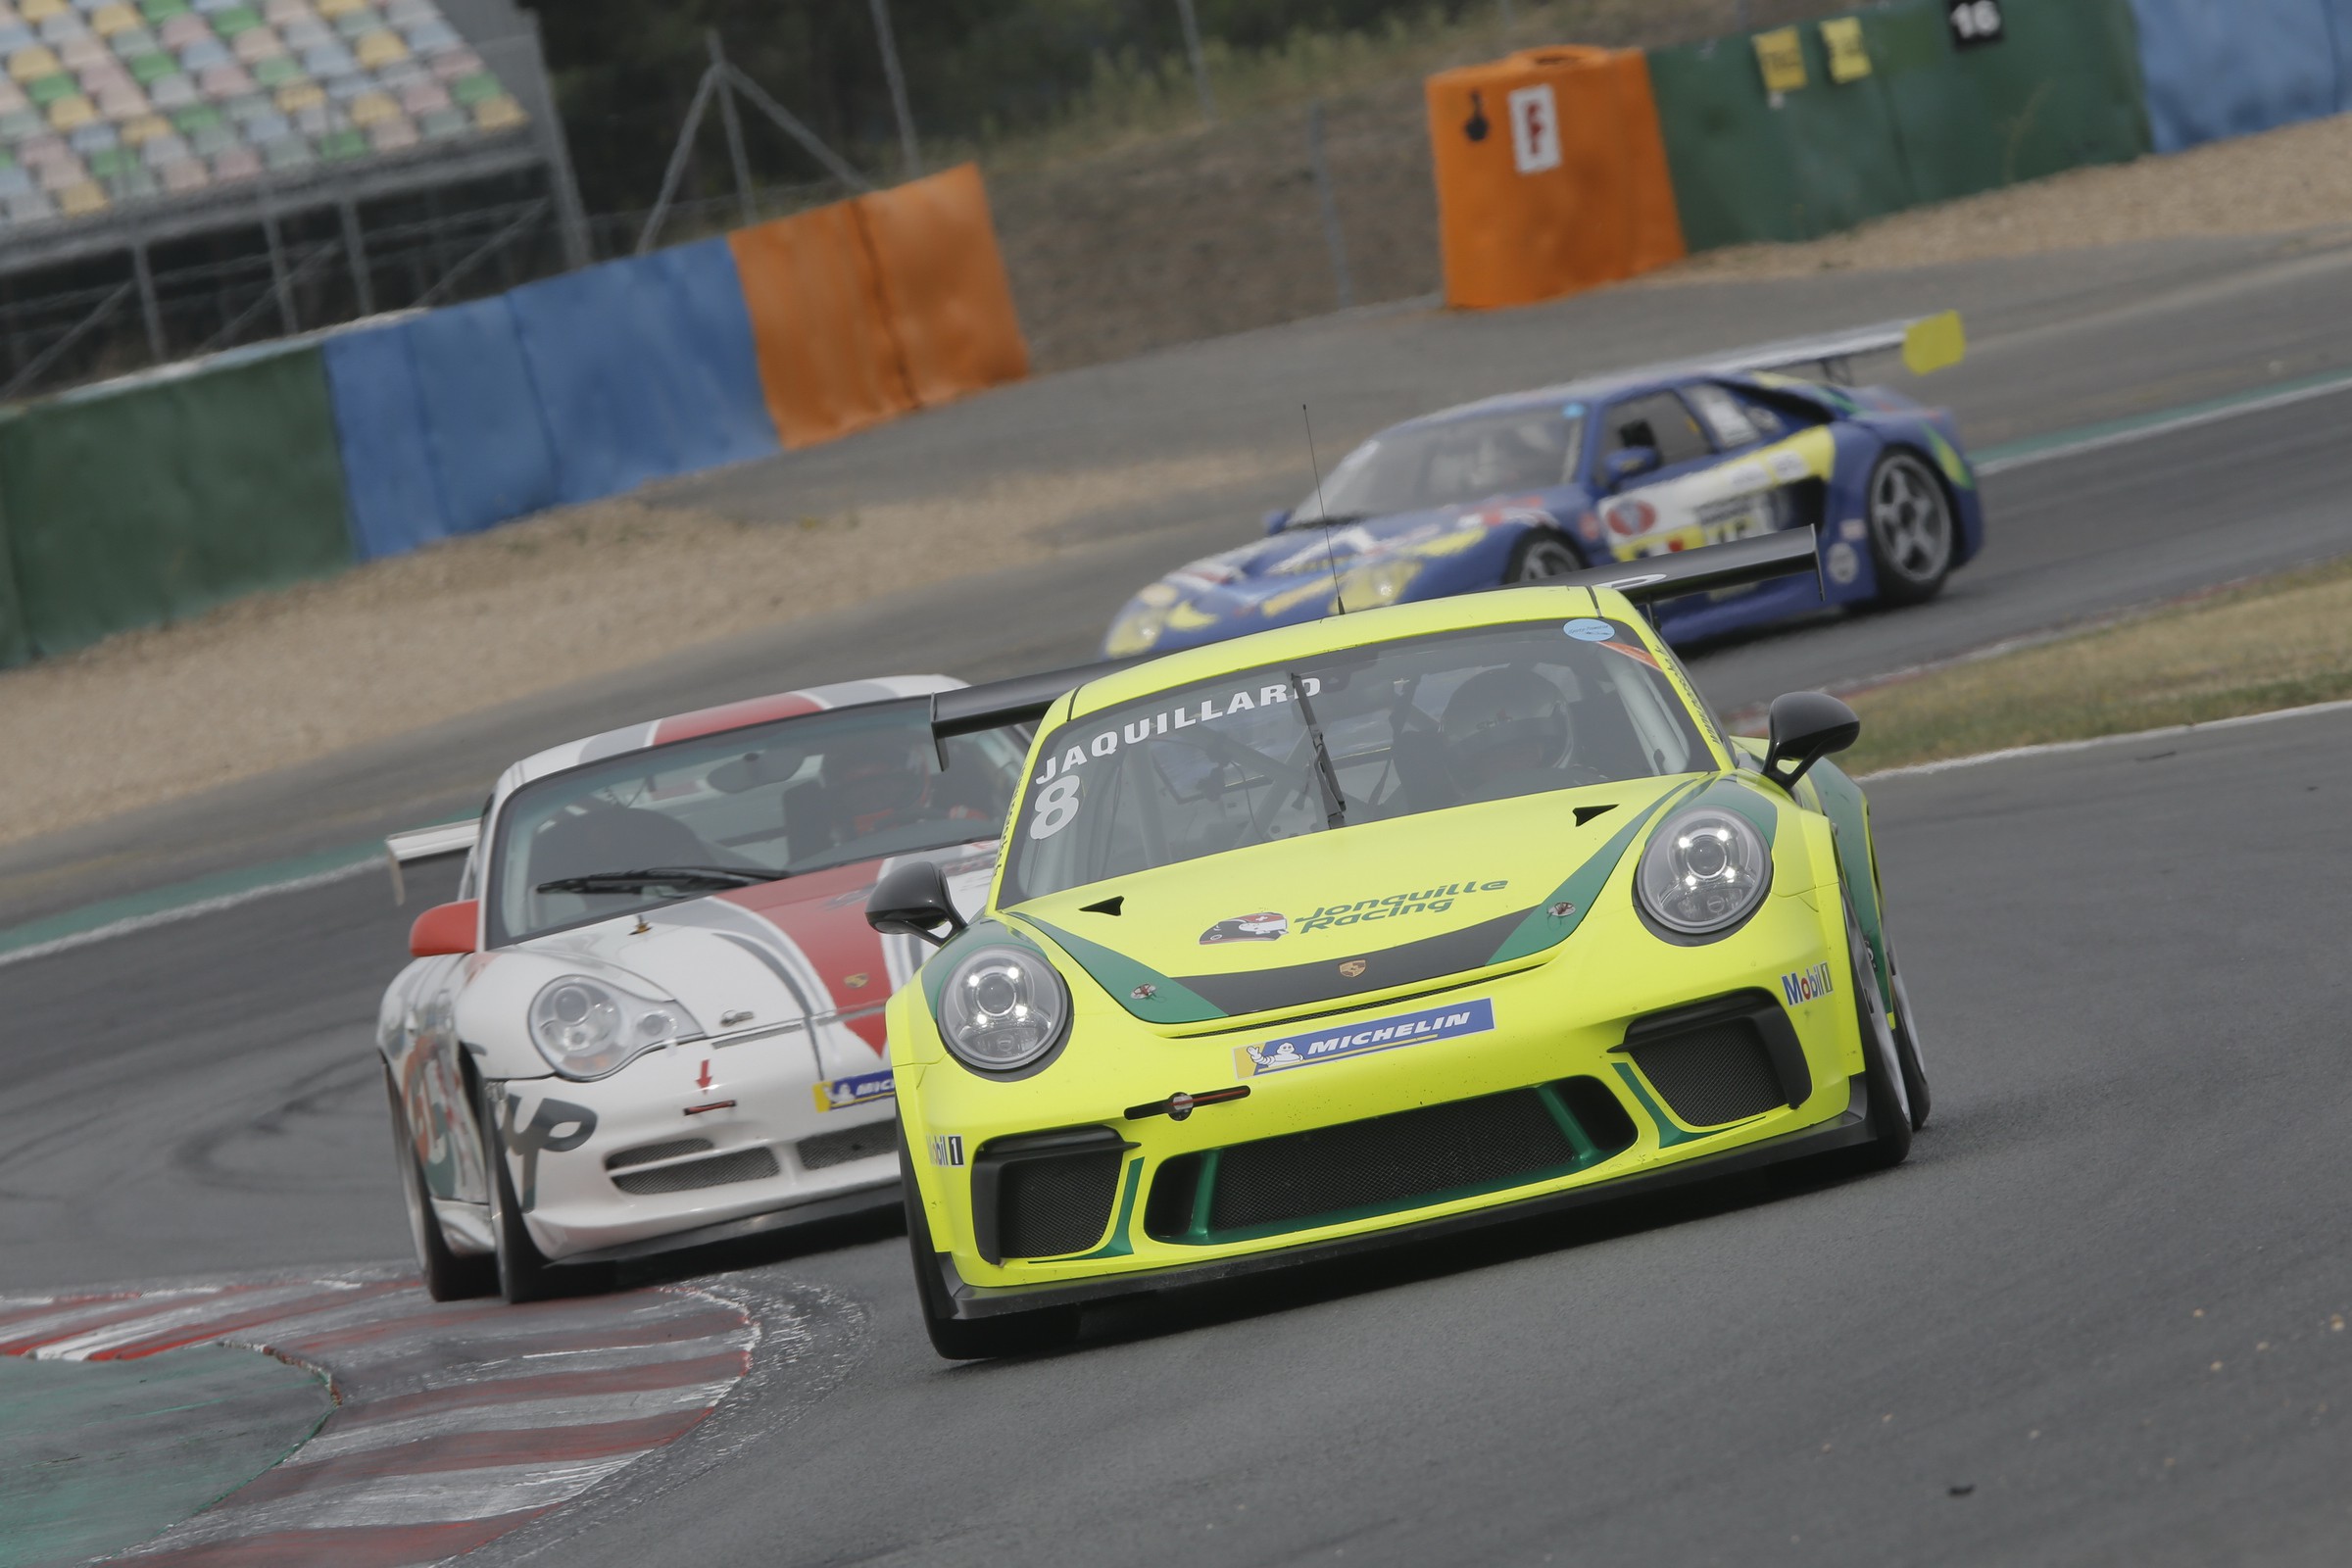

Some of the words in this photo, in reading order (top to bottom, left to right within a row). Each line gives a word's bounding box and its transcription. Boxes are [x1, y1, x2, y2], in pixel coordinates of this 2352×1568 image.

[1950, 1, 2000, 37] 16
[1035, 677, 1321, 785] JAQUILLARD
[1030, 774, 1080, 840] 8
[1294, 879, 1509, 924] Jonquille
[1299, 897, 1455, 935] Racing
[1307, 1011, 1471, 1055] MICHELIN
